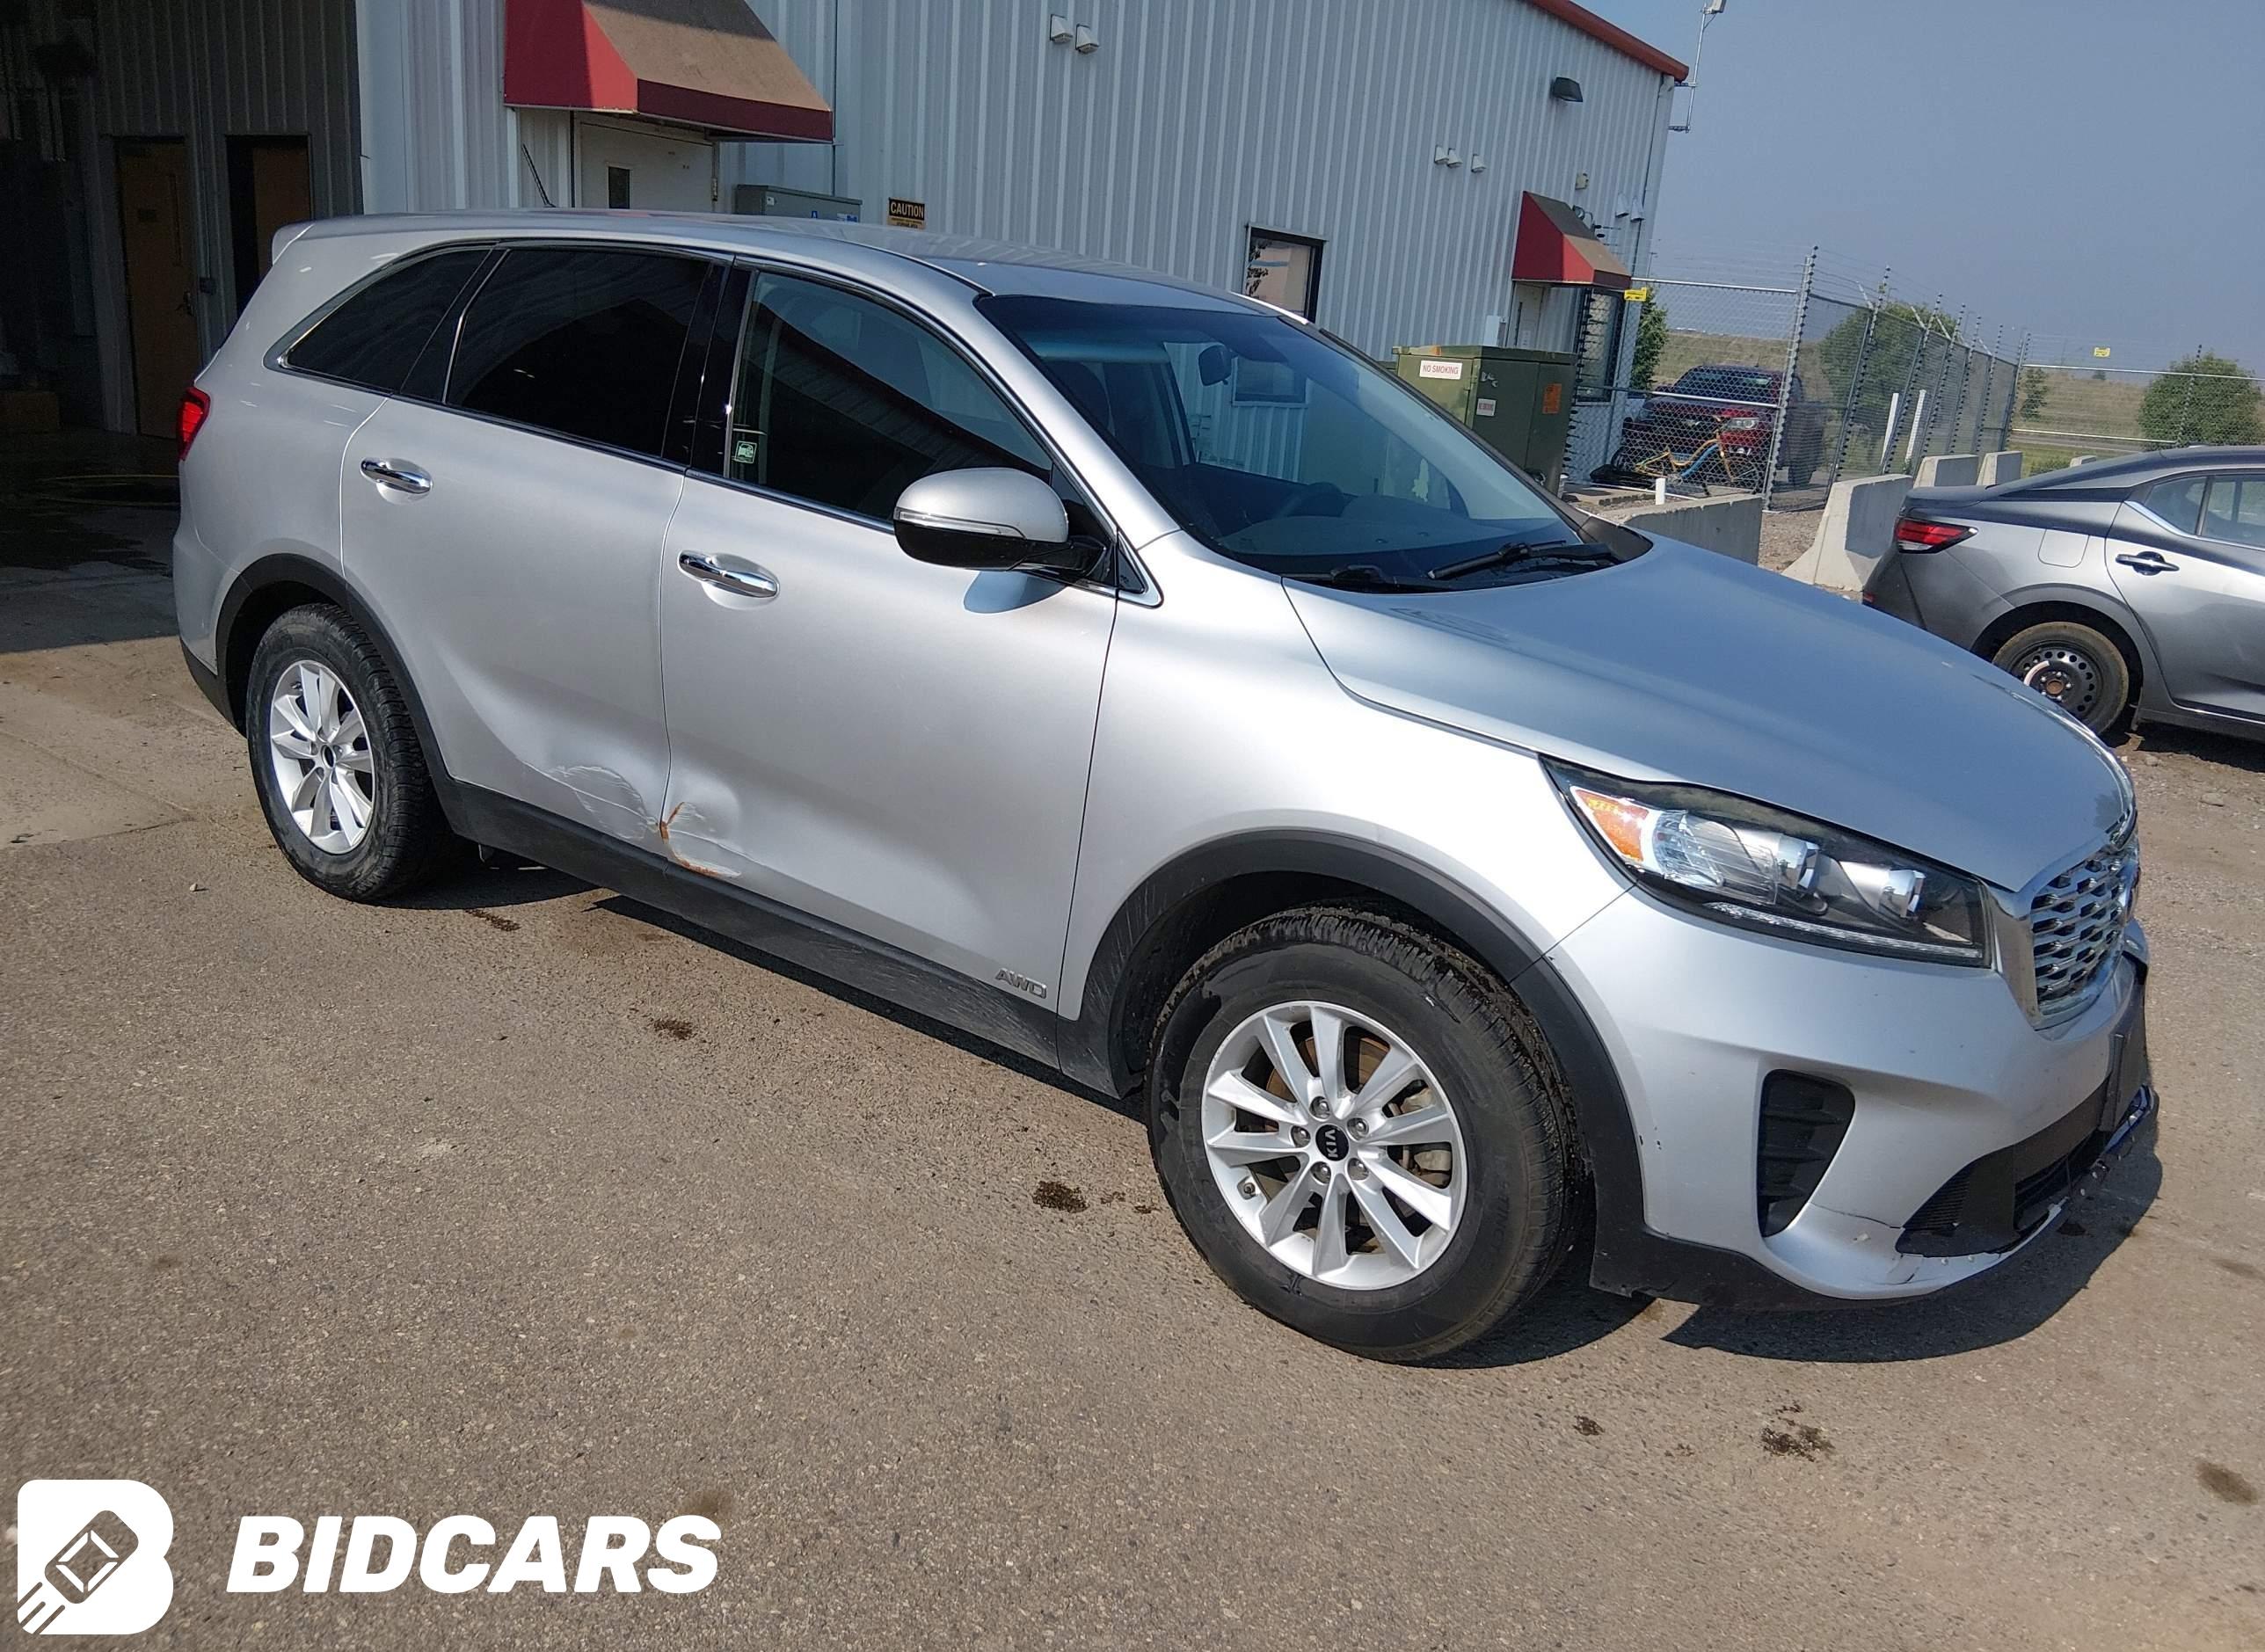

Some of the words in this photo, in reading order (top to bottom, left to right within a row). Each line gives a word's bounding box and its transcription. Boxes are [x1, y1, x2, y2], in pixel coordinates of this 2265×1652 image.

[890, 202, 924, 218] CAUTION
[1432, 365, 1459, 375] SMOKING
[995, 967, 1047, 999] AWD
[1324, 1129, 1338, 1158] KIA
